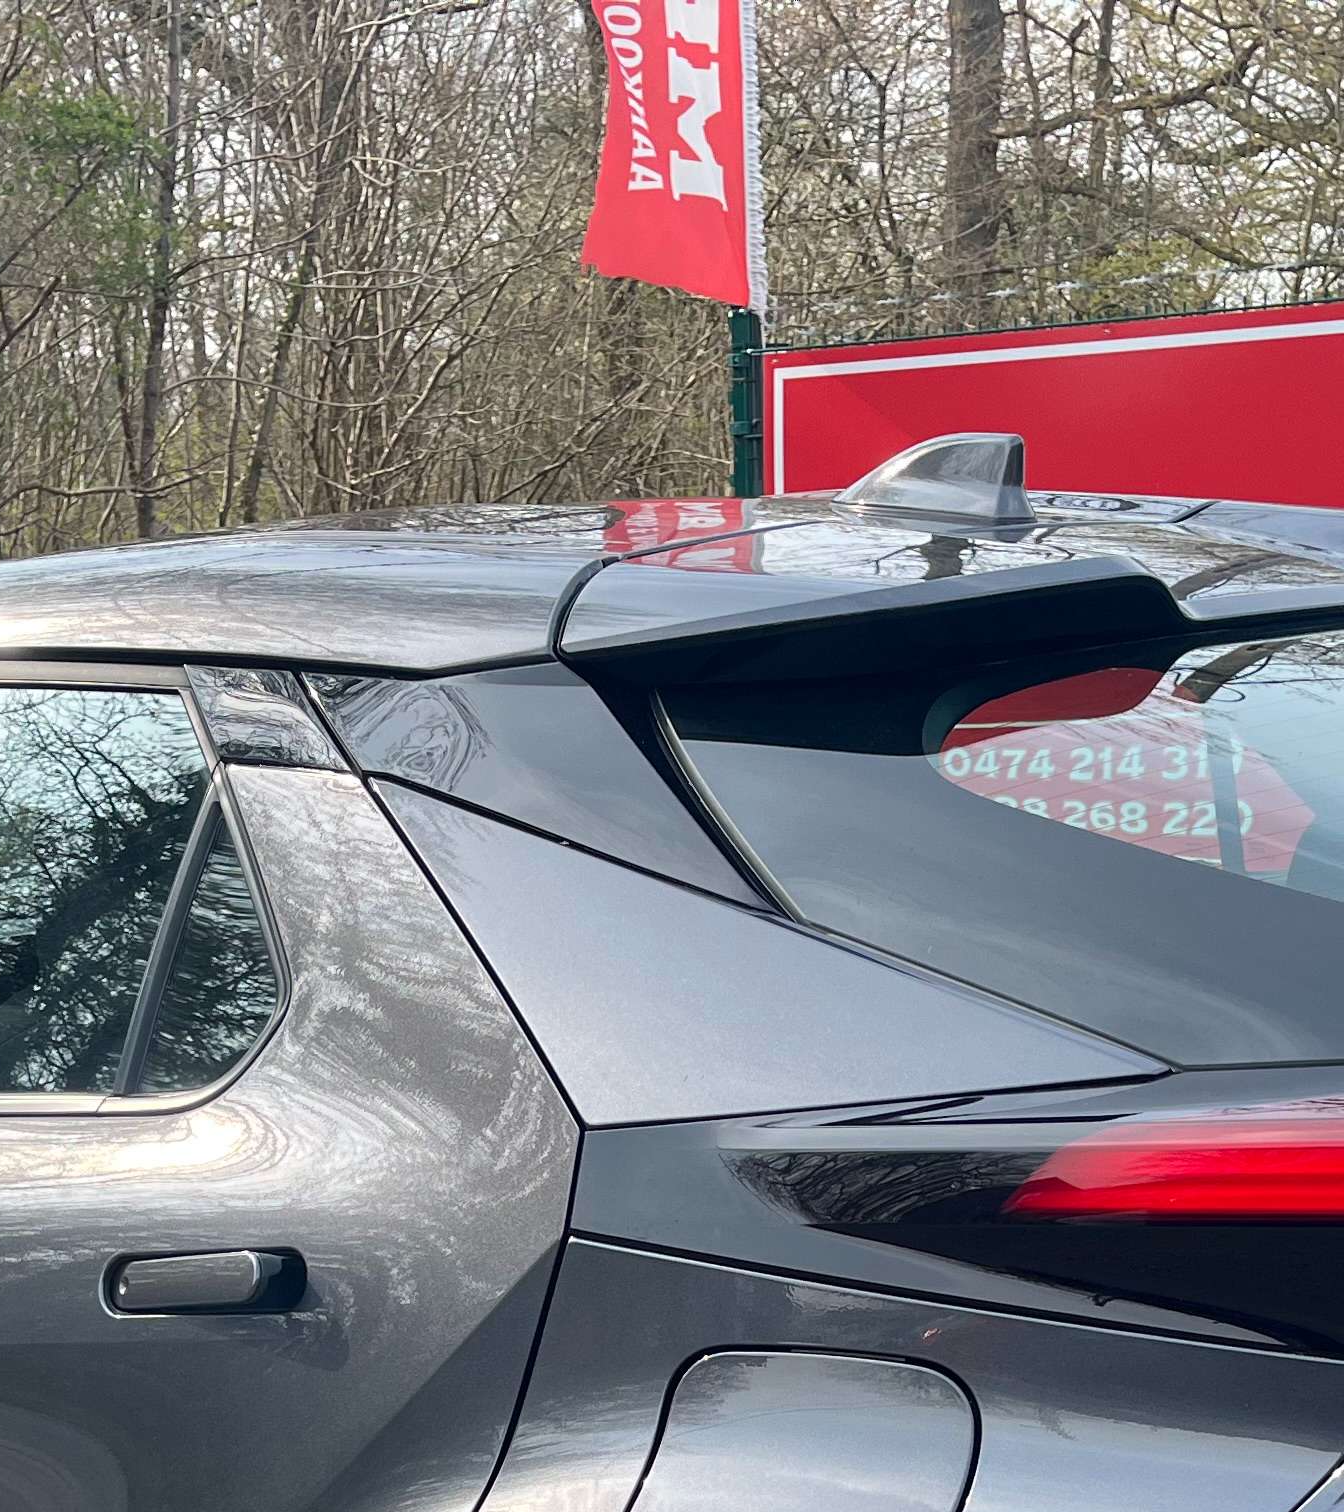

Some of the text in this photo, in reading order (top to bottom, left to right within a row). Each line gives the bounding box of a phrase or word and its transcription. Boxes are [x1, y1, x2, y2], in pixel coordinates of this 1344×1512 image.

[943, 745, 1055, 780] 0474
[1069, 744, 1146, 782] 214
[1062, 800, 1148, 834] 268
